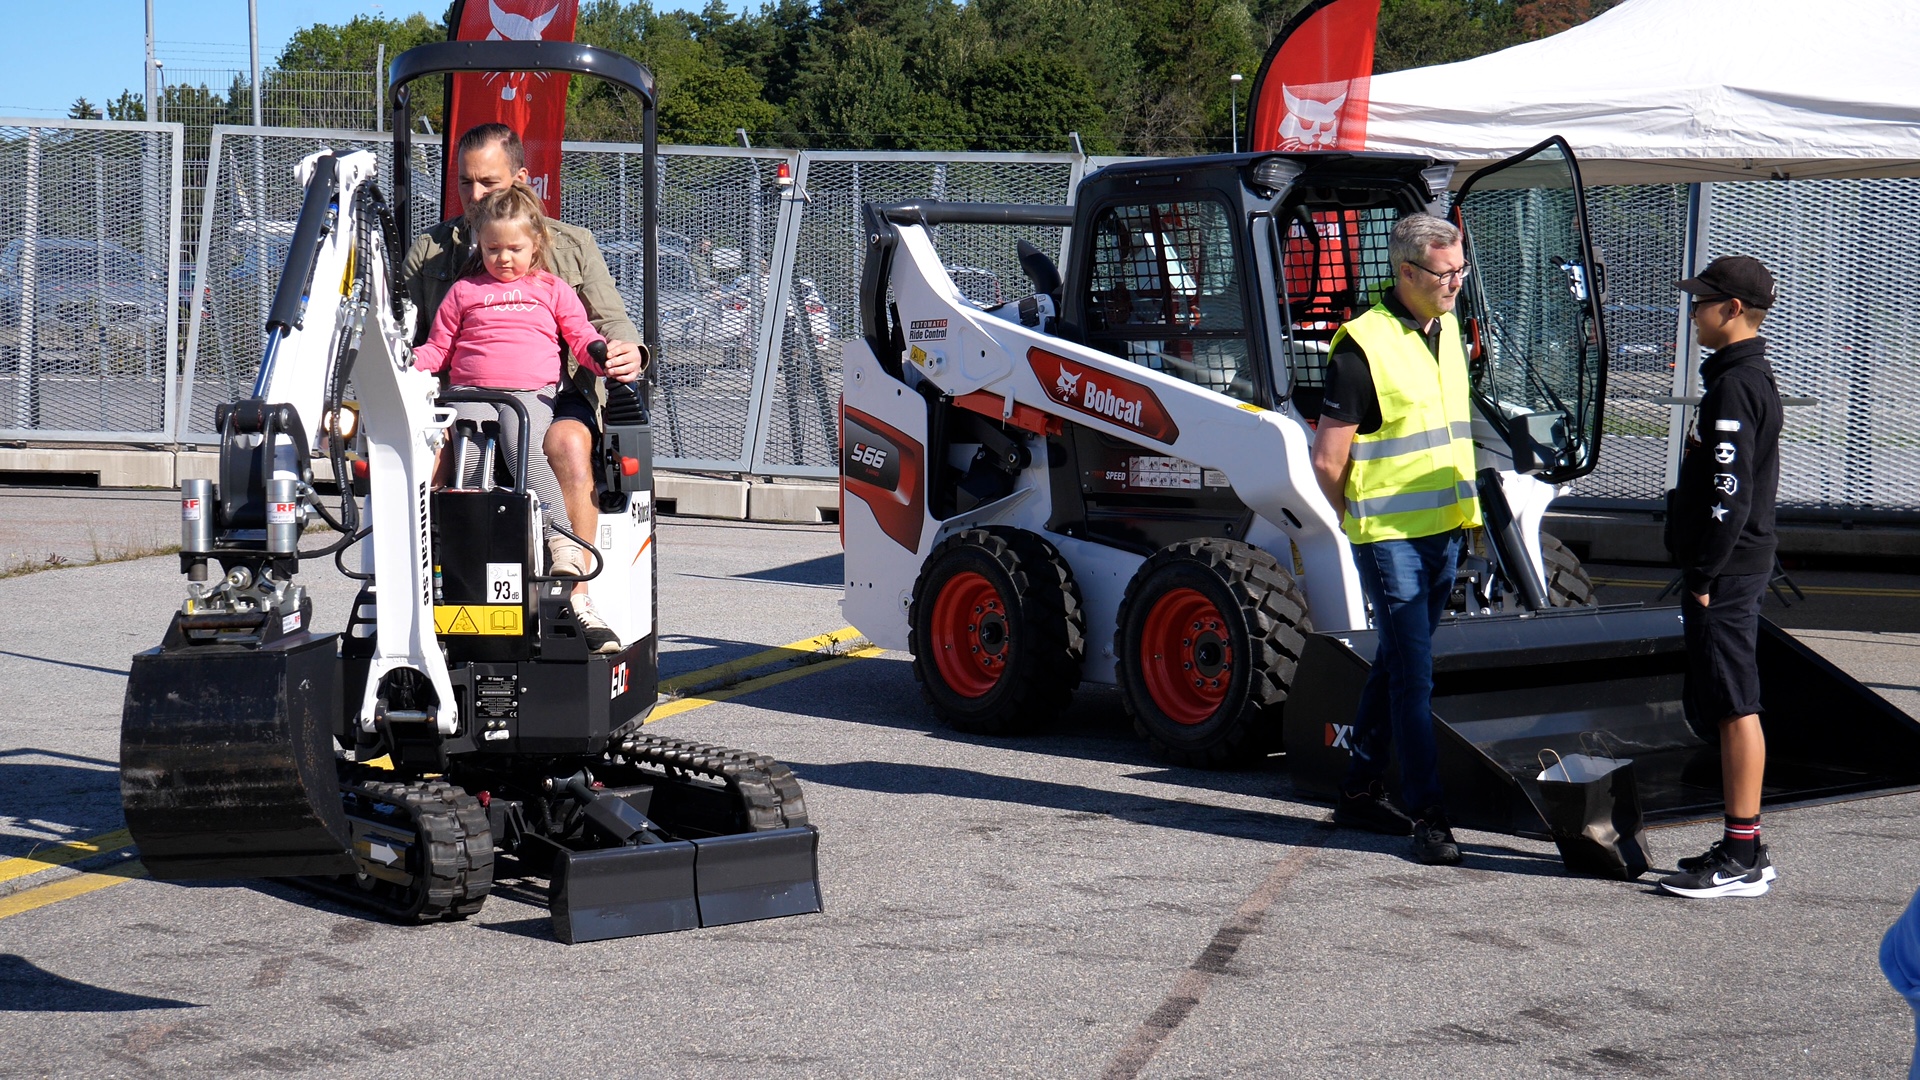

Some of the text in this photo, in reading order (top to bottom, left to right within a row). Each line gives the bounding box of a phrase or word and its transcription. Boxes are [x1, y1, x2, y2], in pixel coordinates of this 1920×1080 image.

[911, 320, 947, 328] AUTOMATIC
[909, 328, 947, 339] Ride Control
[1083, 381, 1142, 427] Bobcat
[1105, 471, 1126, 481] SPEED
[182, 500, 199, 509] RF
[277, 504, 295, 512] RF
[494, 581, 519, 600] 93 dB
